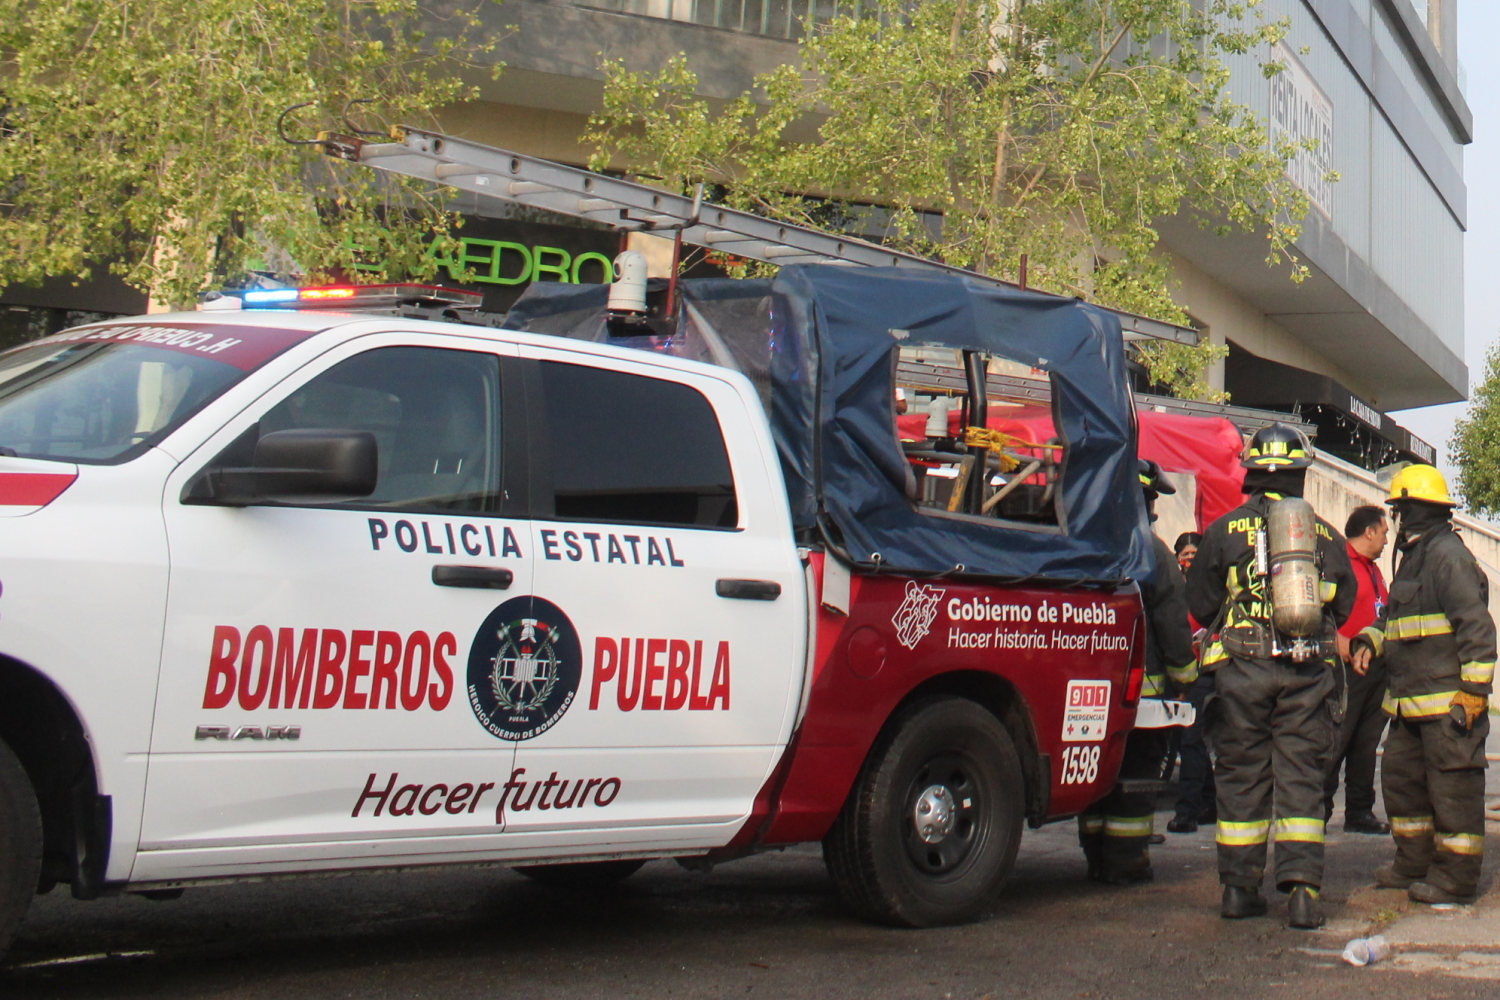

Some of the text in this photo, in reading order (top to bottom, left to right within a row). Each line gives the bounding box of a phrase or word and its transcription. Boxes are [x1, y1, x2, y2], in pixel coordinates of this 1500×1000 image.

[368, 518, 685, 567] POLICIA ESTATAL
[947, 596, 1116, 625] Gobierno de Puebla
[947, 627, 1129, 655] Hacer historia. Hacer futuro.
[202, 624, 457, 711] BOMBEROS
[588, 636, 730, 712] PUEBLA
[468, 684, 575, 740] HEROICO CUERPO DE BOMBEROS
[1071, 688, 1105, 705] 911
[194, 725, 301, 741] RAM
[1067, 714, 1105, 722] EMERGENCIAS
[1061, 745, 1101, 785] 1598
[351, 768, 622, 825] Hacer futuro
